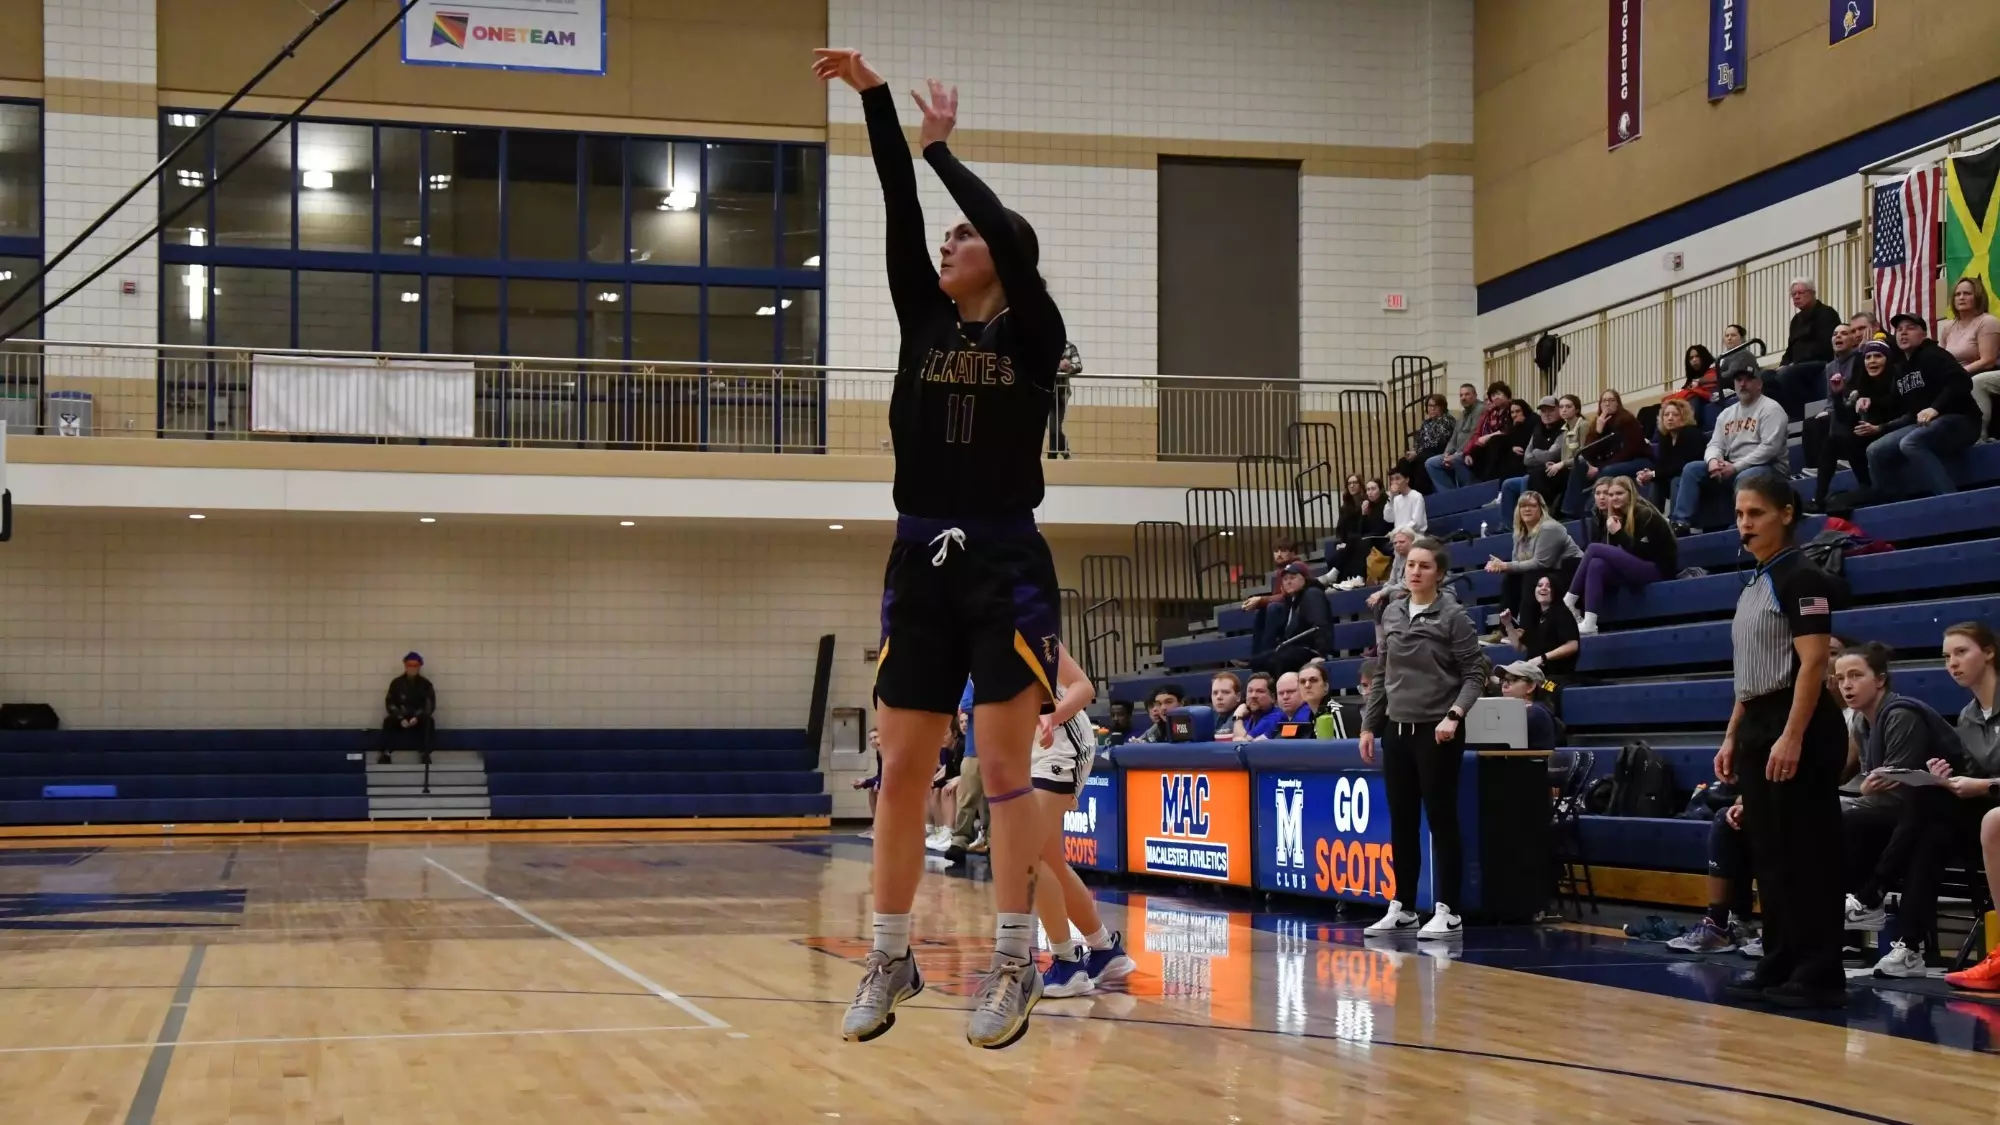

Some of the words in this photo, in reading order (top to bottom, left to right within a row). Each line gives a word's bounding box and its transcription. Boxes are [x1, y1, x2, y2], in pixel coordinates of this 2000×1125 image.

[471, 25, 576, 46] ONETEAM
[1387, 294, 1402, 307] EXIT
[946, 394, 975, 443] 11
[1161, 774, 1210, 838] MAC
[1333, 776, 1370, 834] GO
[1146, 845, 1189, 867] MACALESTER
[1189, 849, 1227, 871] ATHLETICS
[1315, 837, 1397, 901] SCOTS
[1276, 872, 1306, 890] CLUB
